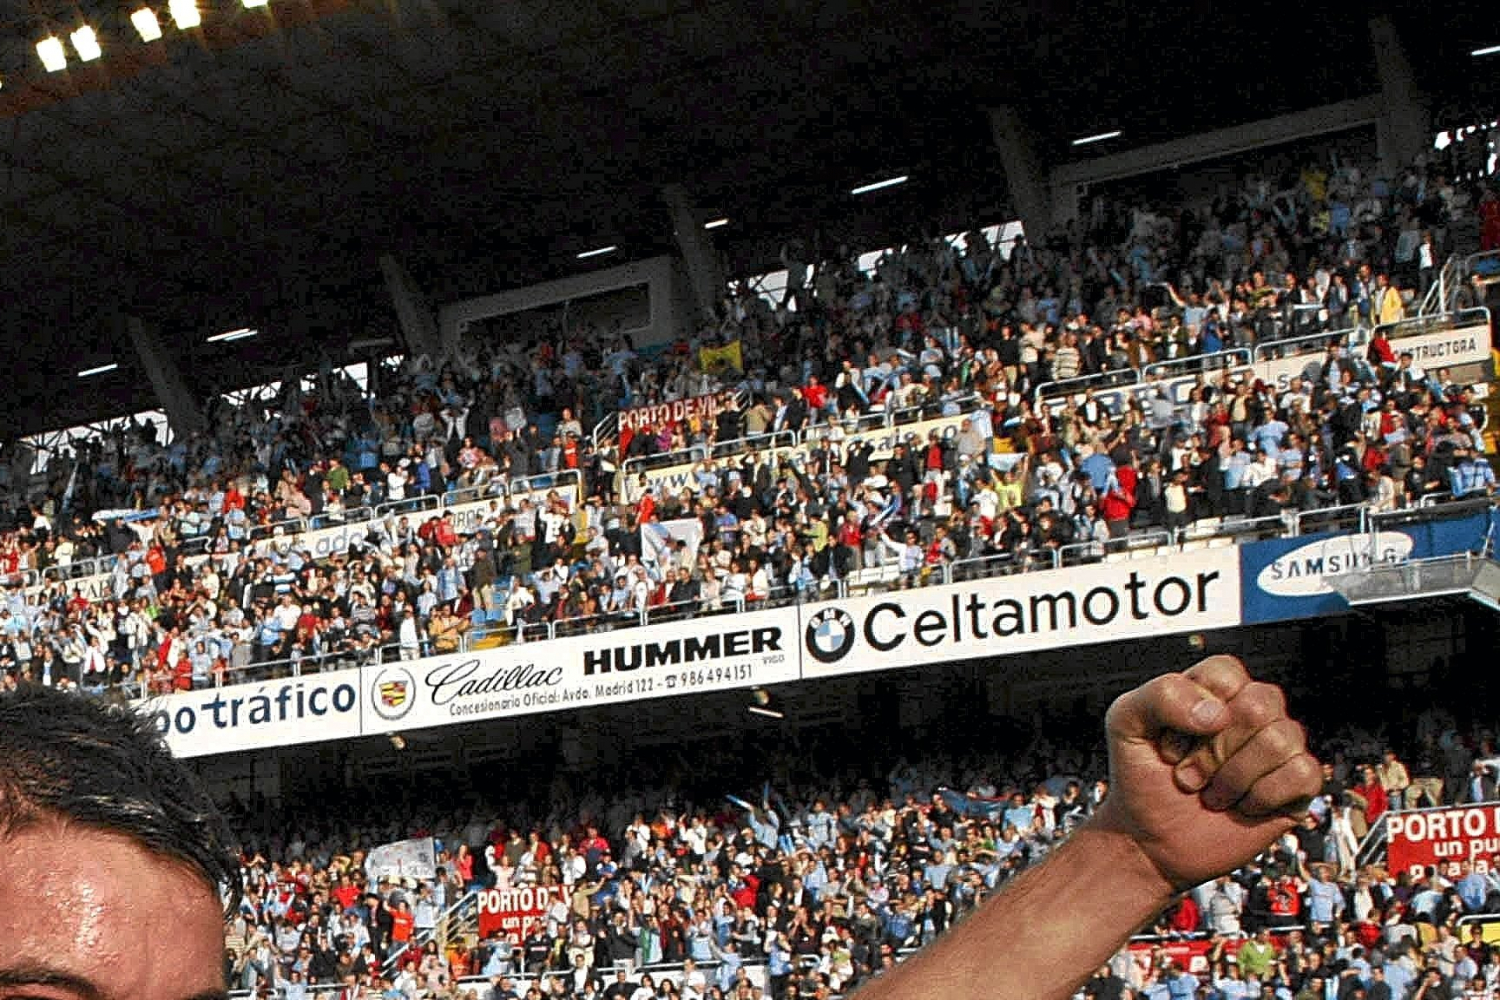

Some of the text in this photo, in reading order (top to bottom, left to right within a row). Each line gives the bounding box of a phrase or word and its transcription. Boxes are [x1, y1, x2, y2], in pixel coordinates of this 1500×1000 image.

[618, 403, 670, 431] PORTO
[674, 399, 695, 422] DE
[863, 570, 1220, 653] Celtamotor
[583, 626, 783, 675] HUMMER
[424, 659, 564, 706] Cadillac
[450, 694, 521, 716] Concesionario
[596, 678, 632, 698] Madrid
[636, 676, 654, 694] 122
[200, 682, 357, 730] tráfico
[1385, 808, 1487, 843] PORTO
[1433, 841, 1463, 857] un
[478, 888, 534, 915] PORTO
[502, 916, 521, 930] un
